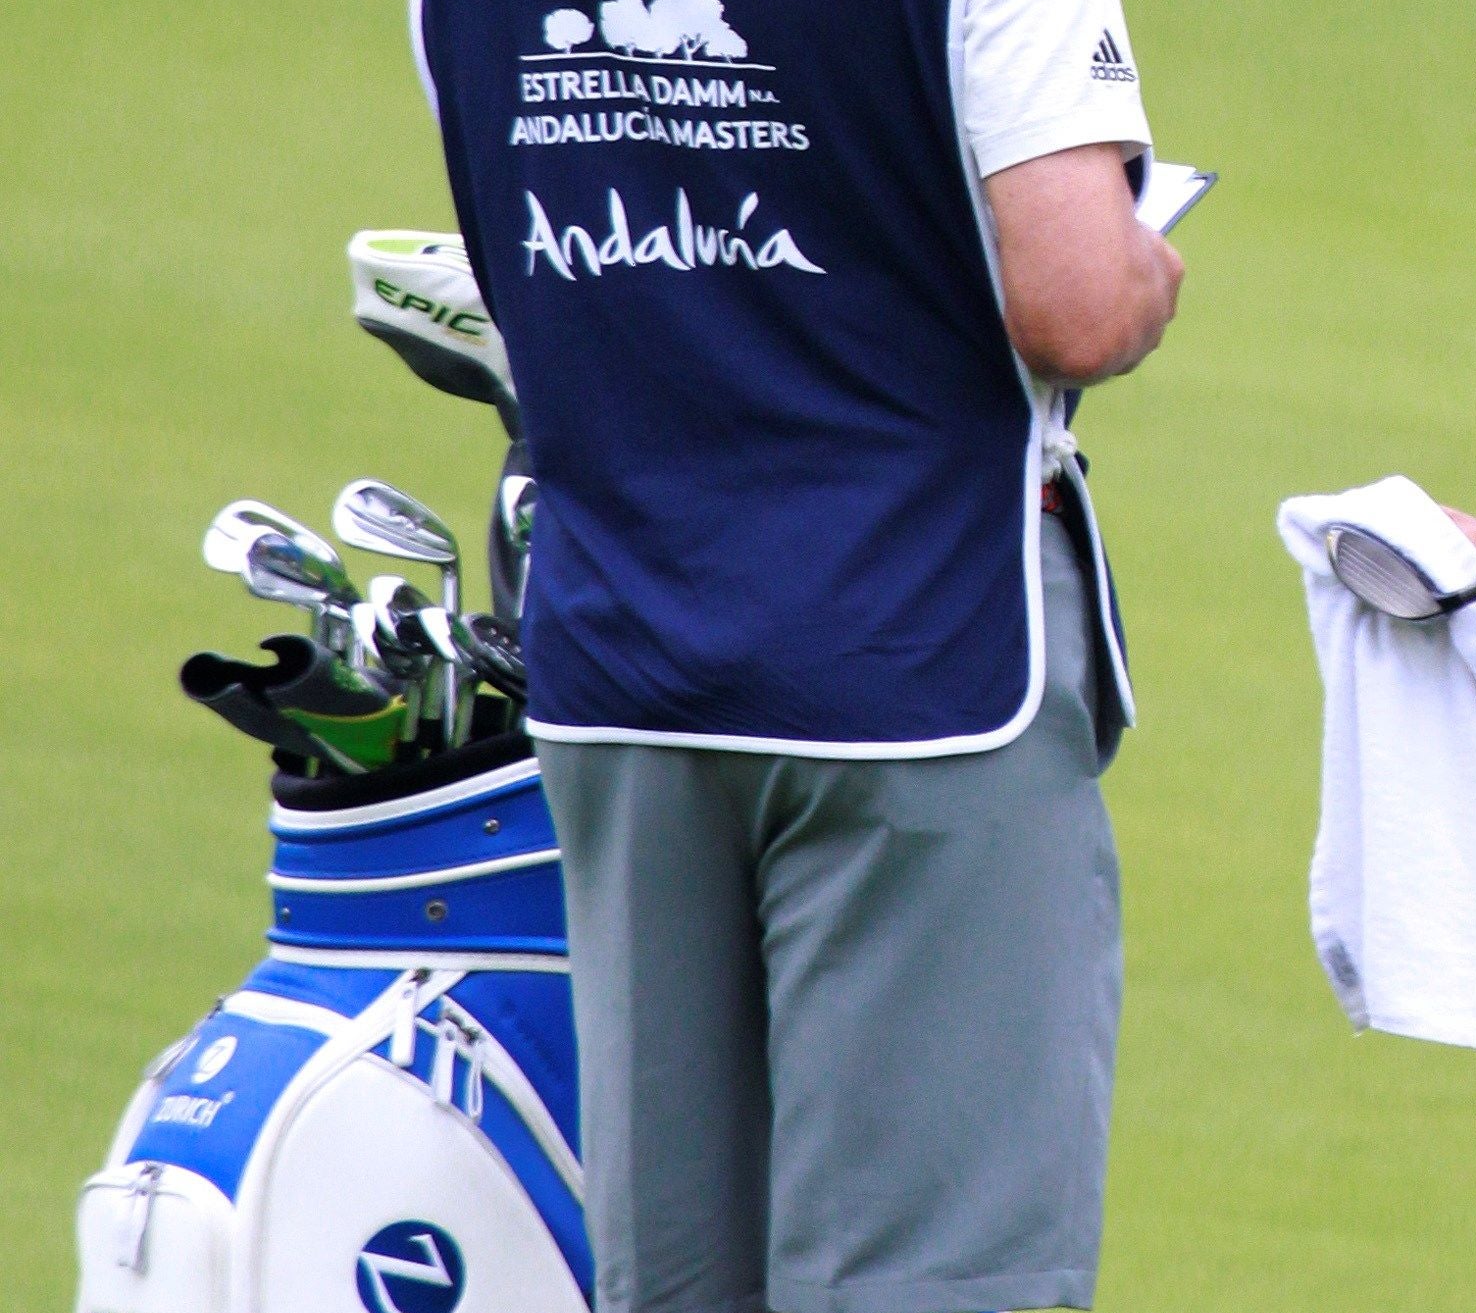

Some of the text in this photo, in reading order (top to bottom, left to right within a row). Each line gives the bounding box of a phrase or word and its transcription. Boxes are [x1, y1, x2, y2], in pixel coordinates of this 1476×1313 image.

[521, 69, 651, 102] ESTRELLA
[651, 76, 747, 108] DAMM
[1091, 65, 1136, 82] adidas
[669, 118, 811, 150] MASTERS
[375, 278, 490, 336] EPIC
